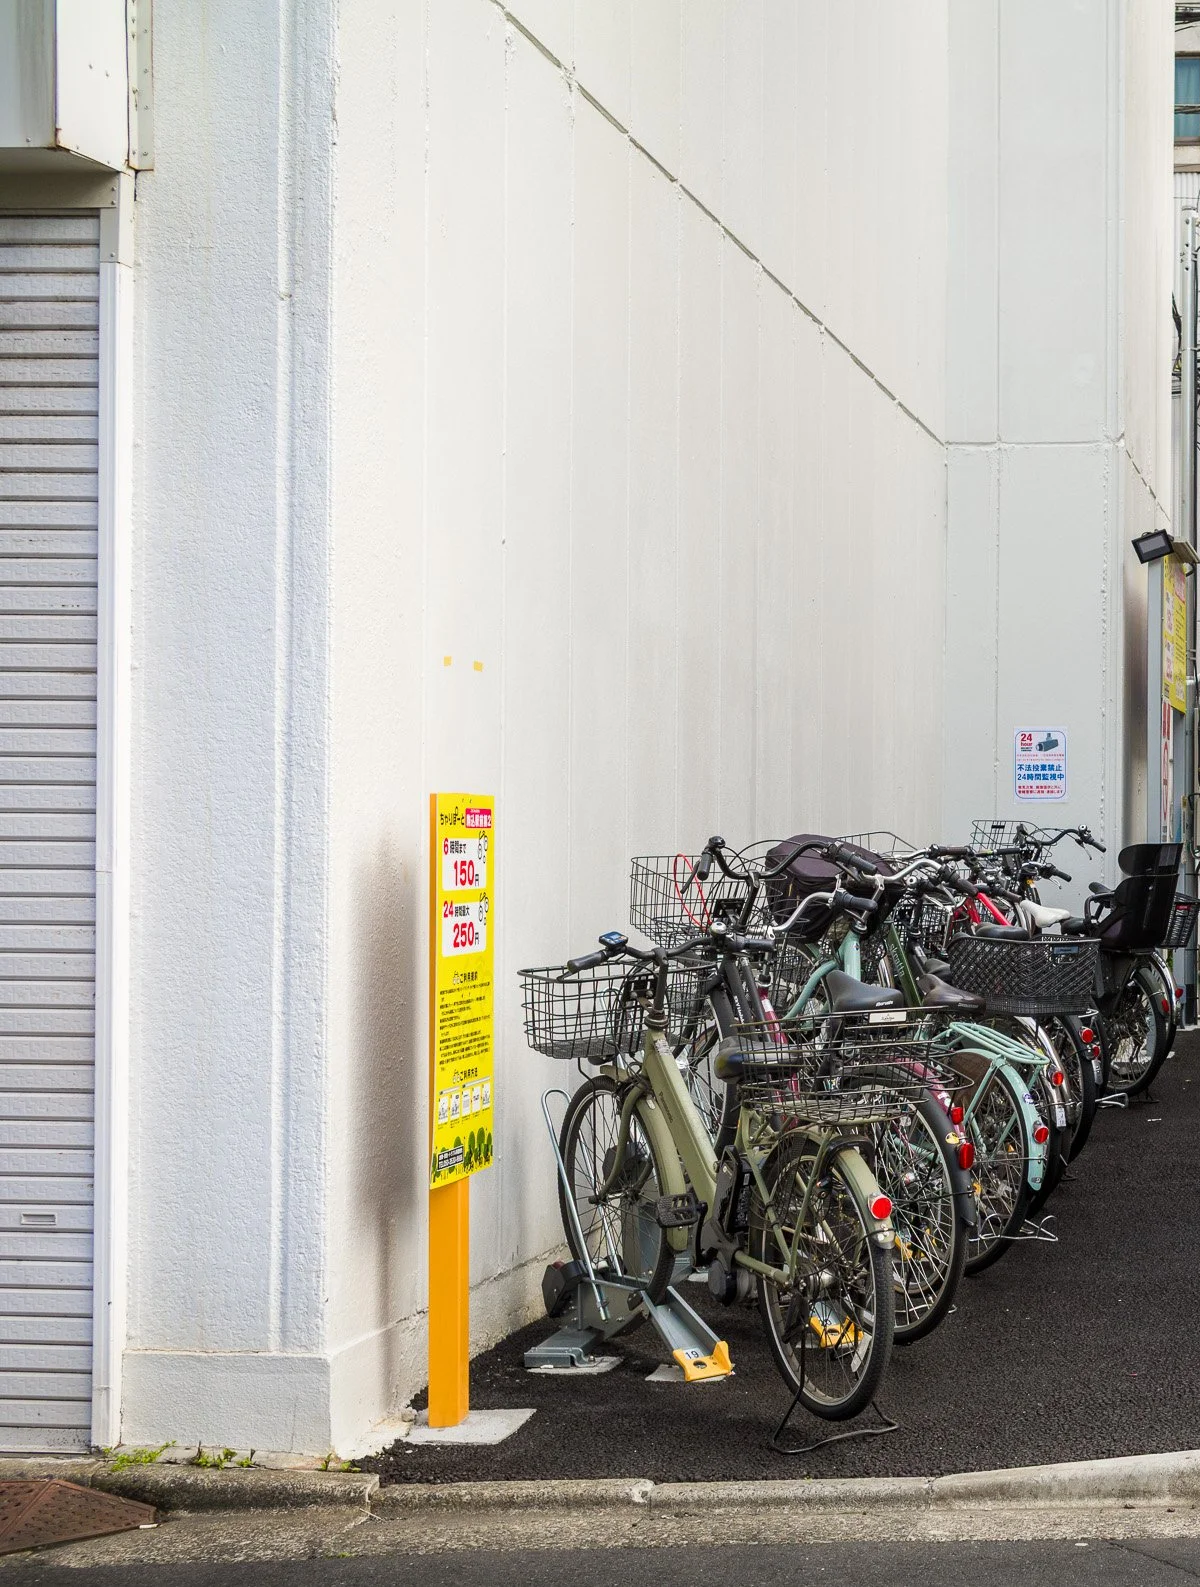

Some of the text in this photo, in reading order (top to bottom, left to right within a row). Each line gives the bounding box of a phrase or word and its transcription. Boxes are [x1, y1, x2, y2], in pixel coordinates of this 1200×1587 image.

[1020, 733, 1033, 741] 24
[1017, 763, 1062, 772] 不法投棄禁止
[1017, 773, 1064, 781] 24時間監視中
[440, 806, 465, 826] ちゃりぽーと
[453, 859, 480, 887] 150円
[453, 921, 480, 948] 250円
[684, 1350, 700, 1360] 19
